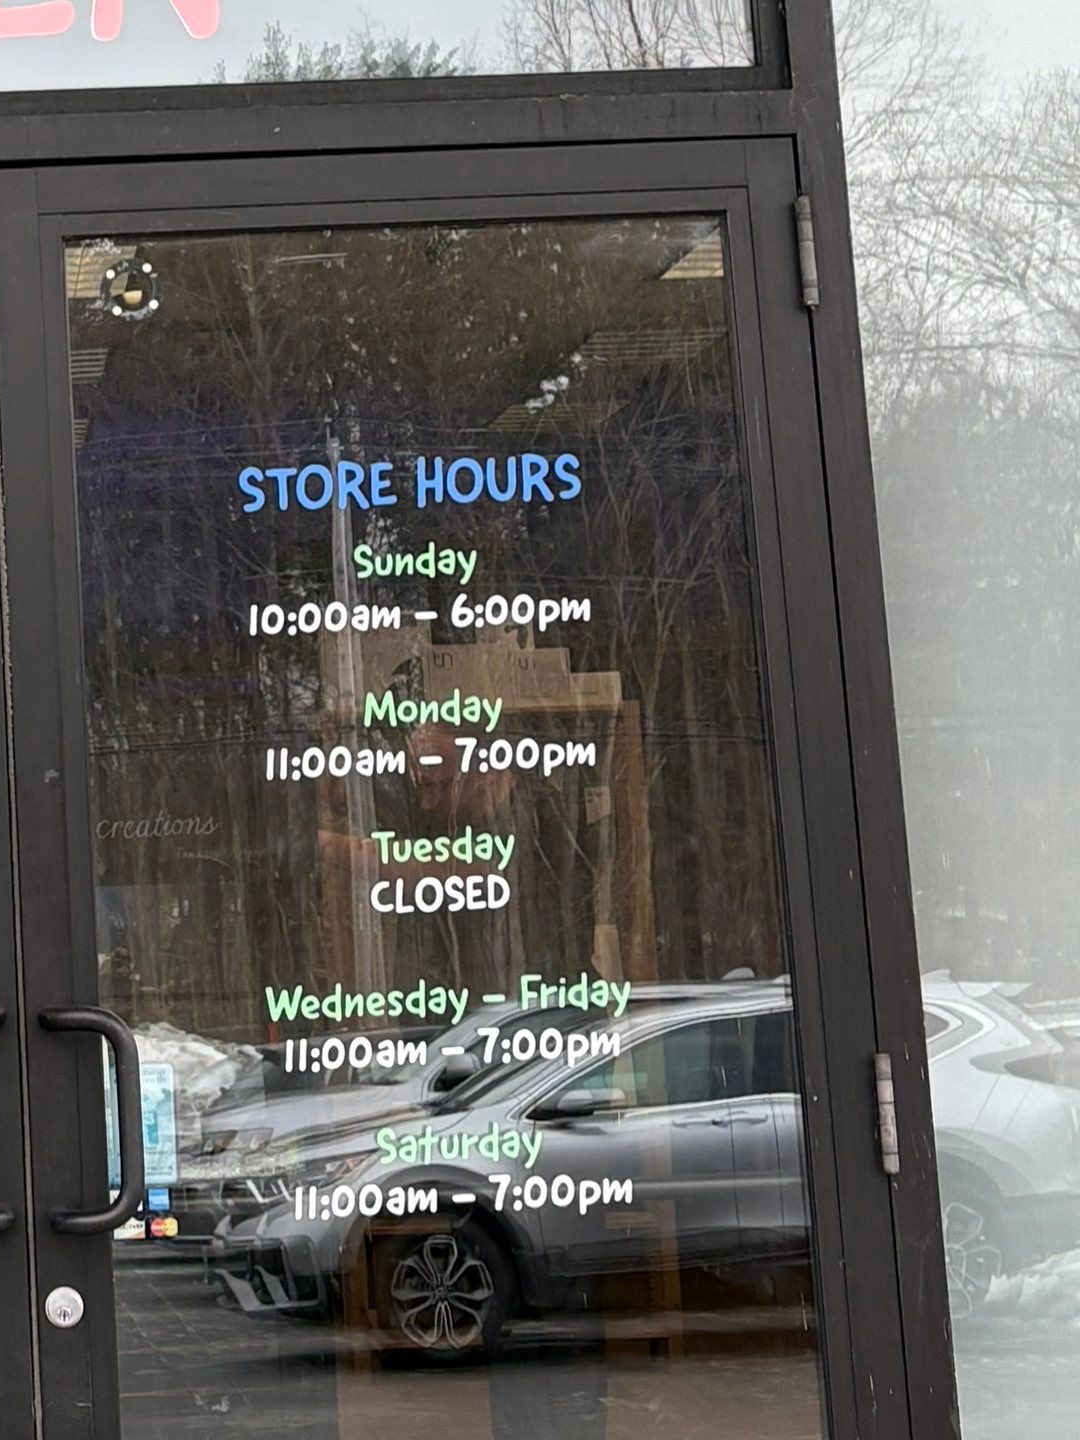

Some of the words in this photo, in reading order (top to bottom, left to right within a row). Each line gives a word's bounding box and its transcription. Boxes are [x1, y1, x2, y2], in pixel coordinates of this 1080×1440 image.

[238, 460, 397, 513] STORE
[416, 453, 582, 508] HOURS
[353, 541, 478, 584] Sunday
[249, 601, 401, 636] 10:00am
[451, 593, 591, 633] 6:00pm
[363, 688, 503, 732] Monday
[265, 745, 406, 781] 11:00am
[454, 737, 596, 777] 7:00pm
[95, 810, 218, 841] creations
[372, 826, 515, 870] Tuesday
[370, 874, 511, 915] CLOSED
[265, 979, 469, 1023] Wednesday
[520, 972, 632, 1016] Friday
[284, 1035, 428, 1074] 11:00am
[476, 1027, 622, 1073] 7:00pm
[376, 1122, 543, 1168] Saturday
[293, 1182, 439, 1222] 11:00am
[487, 1173, 634, 1216] 7:00pm
